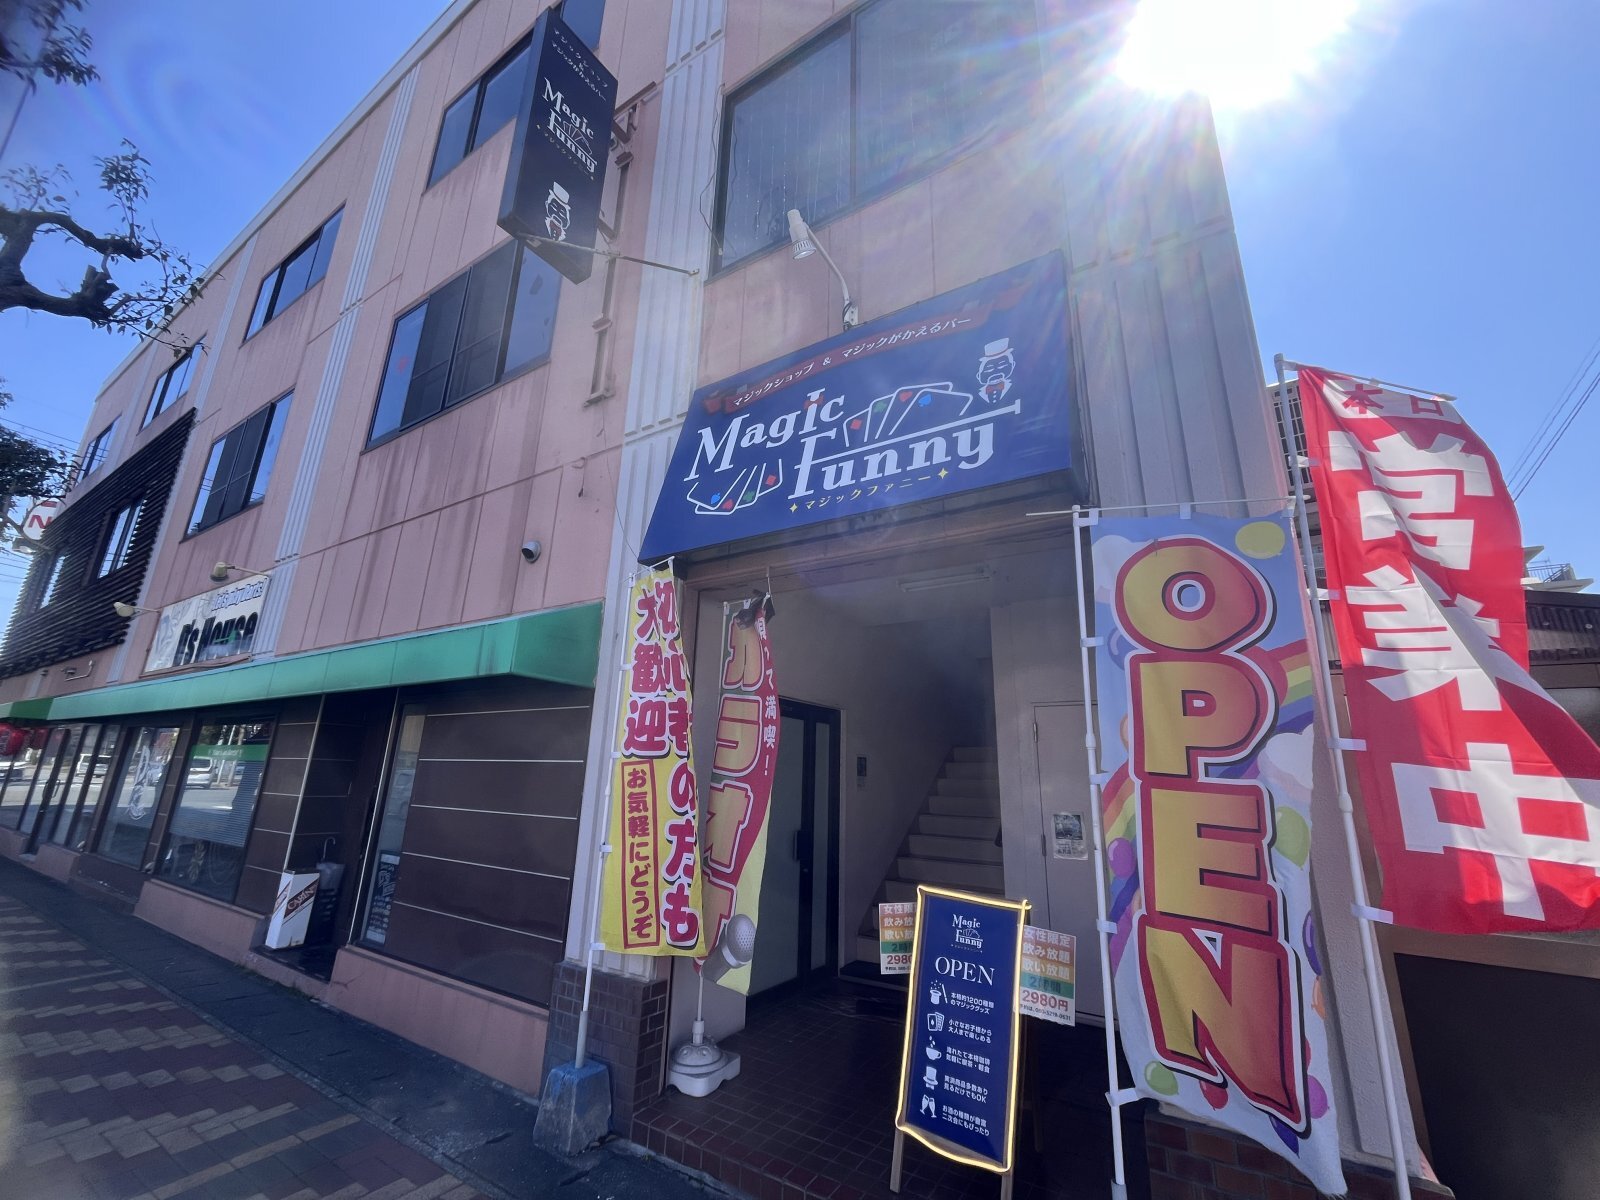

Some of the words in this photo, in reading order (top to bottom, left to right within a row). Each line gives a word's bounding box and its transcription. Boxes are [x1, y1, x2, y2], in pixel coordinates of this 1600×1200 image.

[542, 77, 594, 139] Magic
[547, 109, 598, 173] Funny
[732, 362, 815, 407] マジックショップ
[822, 356, 832, 366] &
[842, 318, 972, 358] マジックがかえるバー
[1340, 383, 1445, 417] 本日
[683, 388, 846, 481] Magic
[788, 400, 1021, 500] Funny
[804, 475, 932, 510] マジックファニー
[624, 587, 668, 754] 大歓迎
[1327, 430, 1600, 922] 営業中
[1110, 535, 1312, 1135] OPEN
[627, 767, 652, 939] お気軽にどうぞ
[884, 904, 917, 914] 女性限
[952, 913, 981, 928] Magic
[955, 929, 984, 948] Funny
[935, 956, 994, 985] OPEN
[950, 992, 995, 1009] 本格約1200種類
[950, 999, 991, 1015] のマジックグッズ
[1022, 990, 1068, 1012] 2980円
[948, 1019, 992, 1037] 小さなお子様から
[948, 1026, 992, 1044] 大人まで楽しめる
[943, 1082, 987, 1104] 見るだけでもOK
[942, 1112, 990, 1137] 二次会にもぴったり
